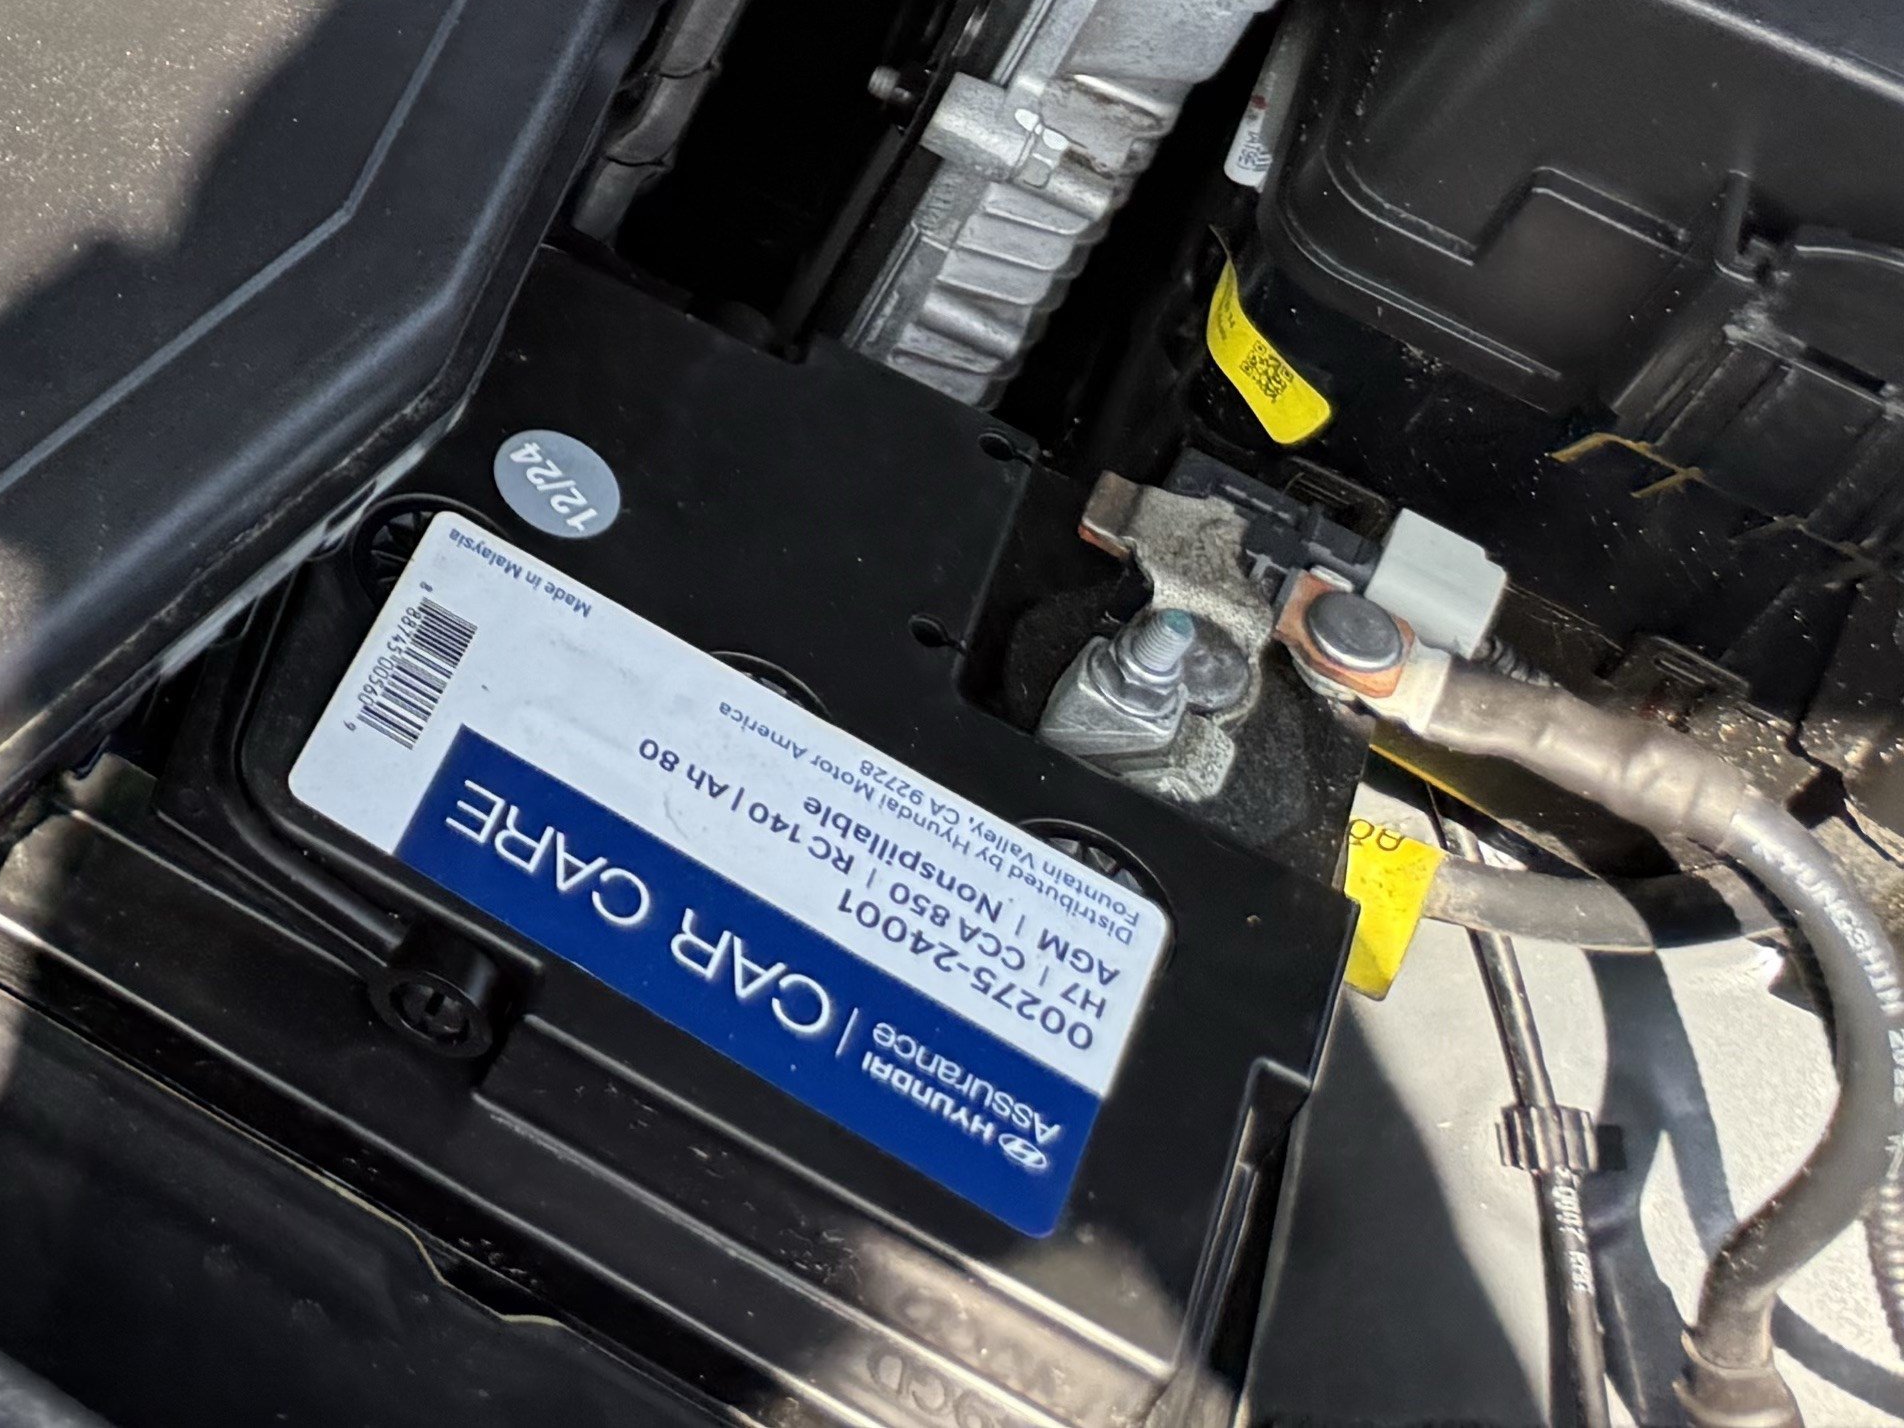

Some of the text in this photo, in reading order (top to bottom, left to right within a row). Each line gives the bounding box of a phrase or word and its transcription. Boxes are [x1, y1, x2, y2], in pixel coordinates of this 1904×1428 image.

[509, 442, 599, 532] 12/24
[418, 580, 434, 594] 8
[448, 527, 593, 619] Made in Malaysia
[342, 720, 358, 733] 9
[356, 655, 397, 711] 00560
[638, 738, 1108, 1021] H7 CCA 850 RC 140 Ah 80
[717, 700, 1134, 947] Distributed by Hyundai Motor America
[802, 795, 1121, 987] AGM Nonspillable
[858, 758, 1141, 928] Fountain Valley, CA 92728
[444, 778, 832, 1036] CAR CARE
[837, 887, 1094, 1051] 00275-24001
[1750, 841, 1904, 1017] KYUNGSHIN
[861, 1050, 996, 1142] HYUNDAI
[871, 1021, 1062, 1146] Assurance
